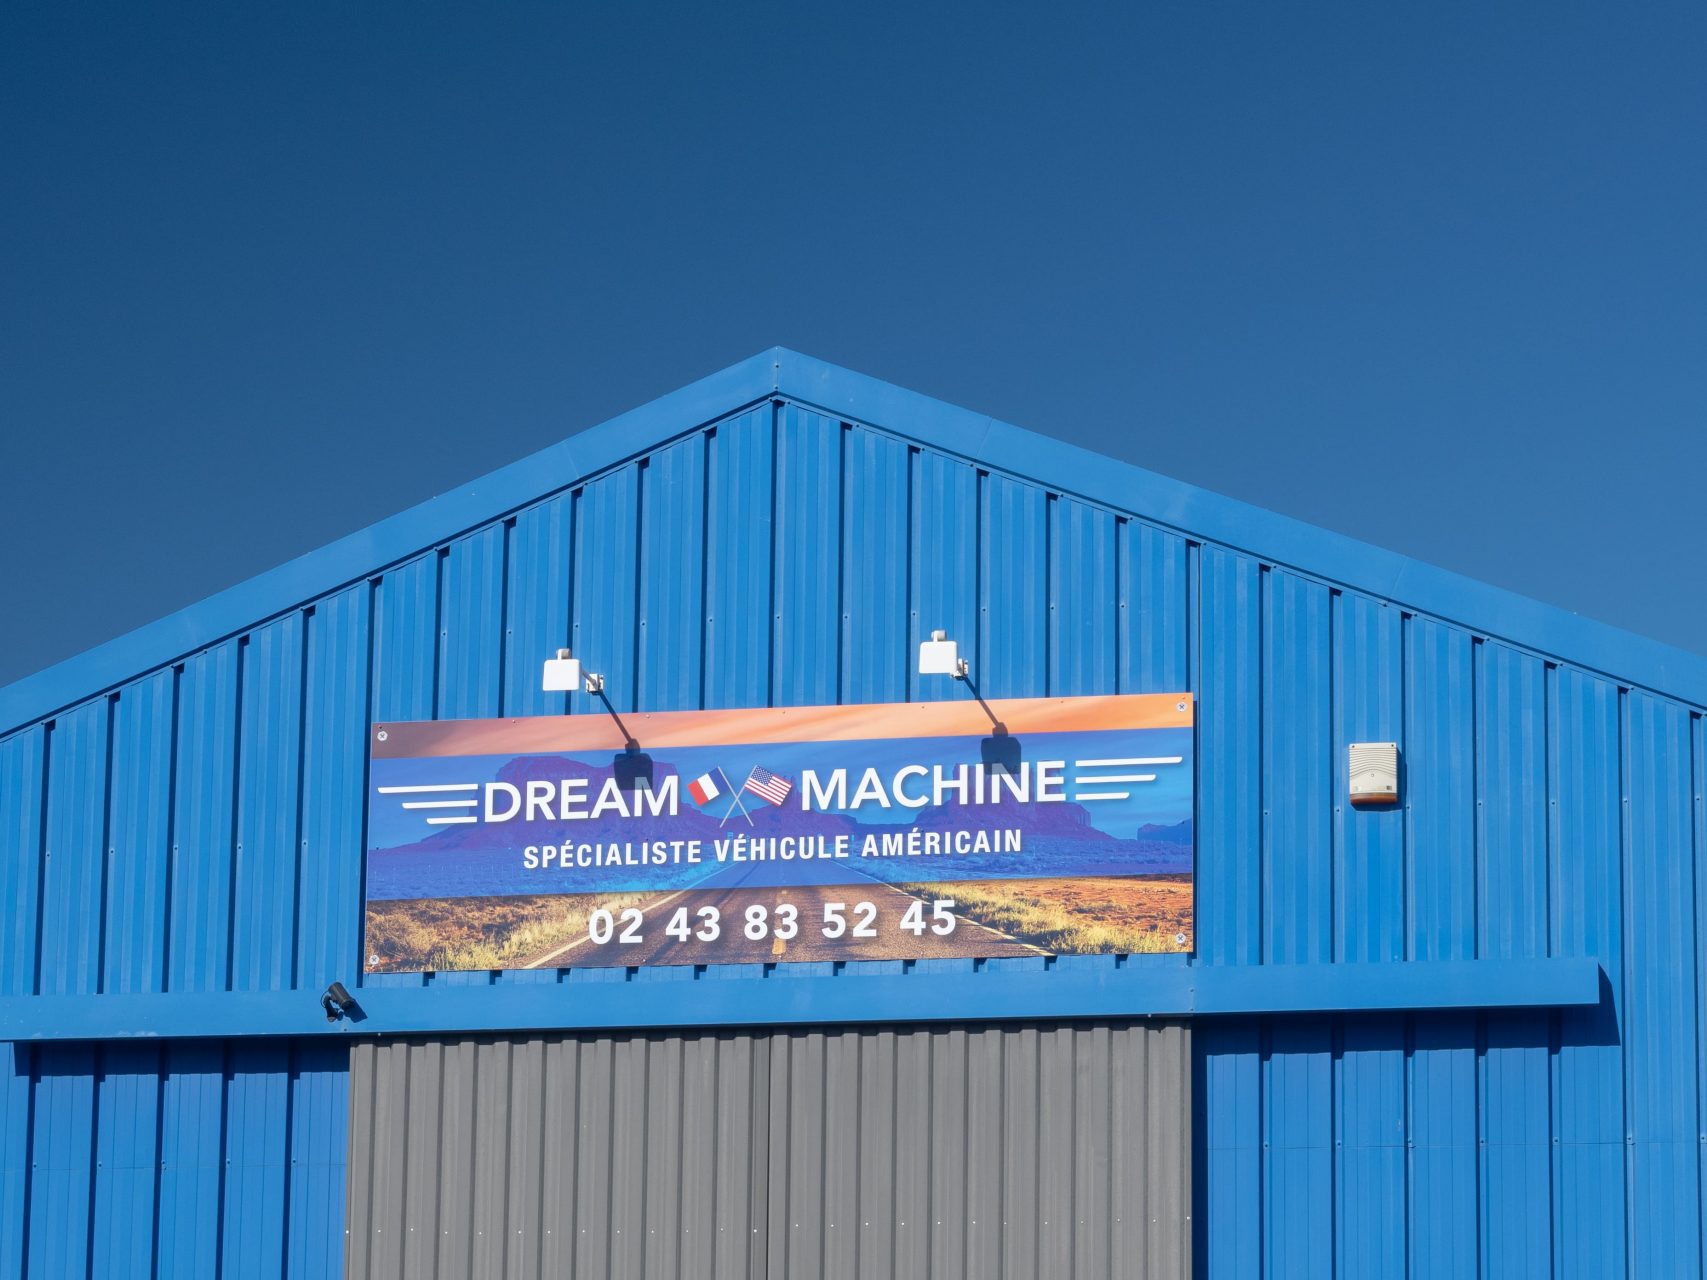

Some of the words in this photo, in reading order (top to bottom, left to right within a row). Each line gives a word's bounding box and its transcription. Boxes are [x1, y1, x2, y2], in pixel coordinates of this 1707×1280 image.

[485, 775, 679, 823] DREAM
[802, 760, 1067, 811] MACHINE
[523, 839, 702, 869] SPÉCIALISTE
[713, 833, 849, 862] VÉHICULE
[861, 827, 1021, 857] AMÉRICAIN
[588, 908, 643, 945] 02
[664, 905, 721, 942] 43
[744, 903, 799, 941] 83
[821, 900, 878, 939] 52
[900, 897, 957, 936] 45
